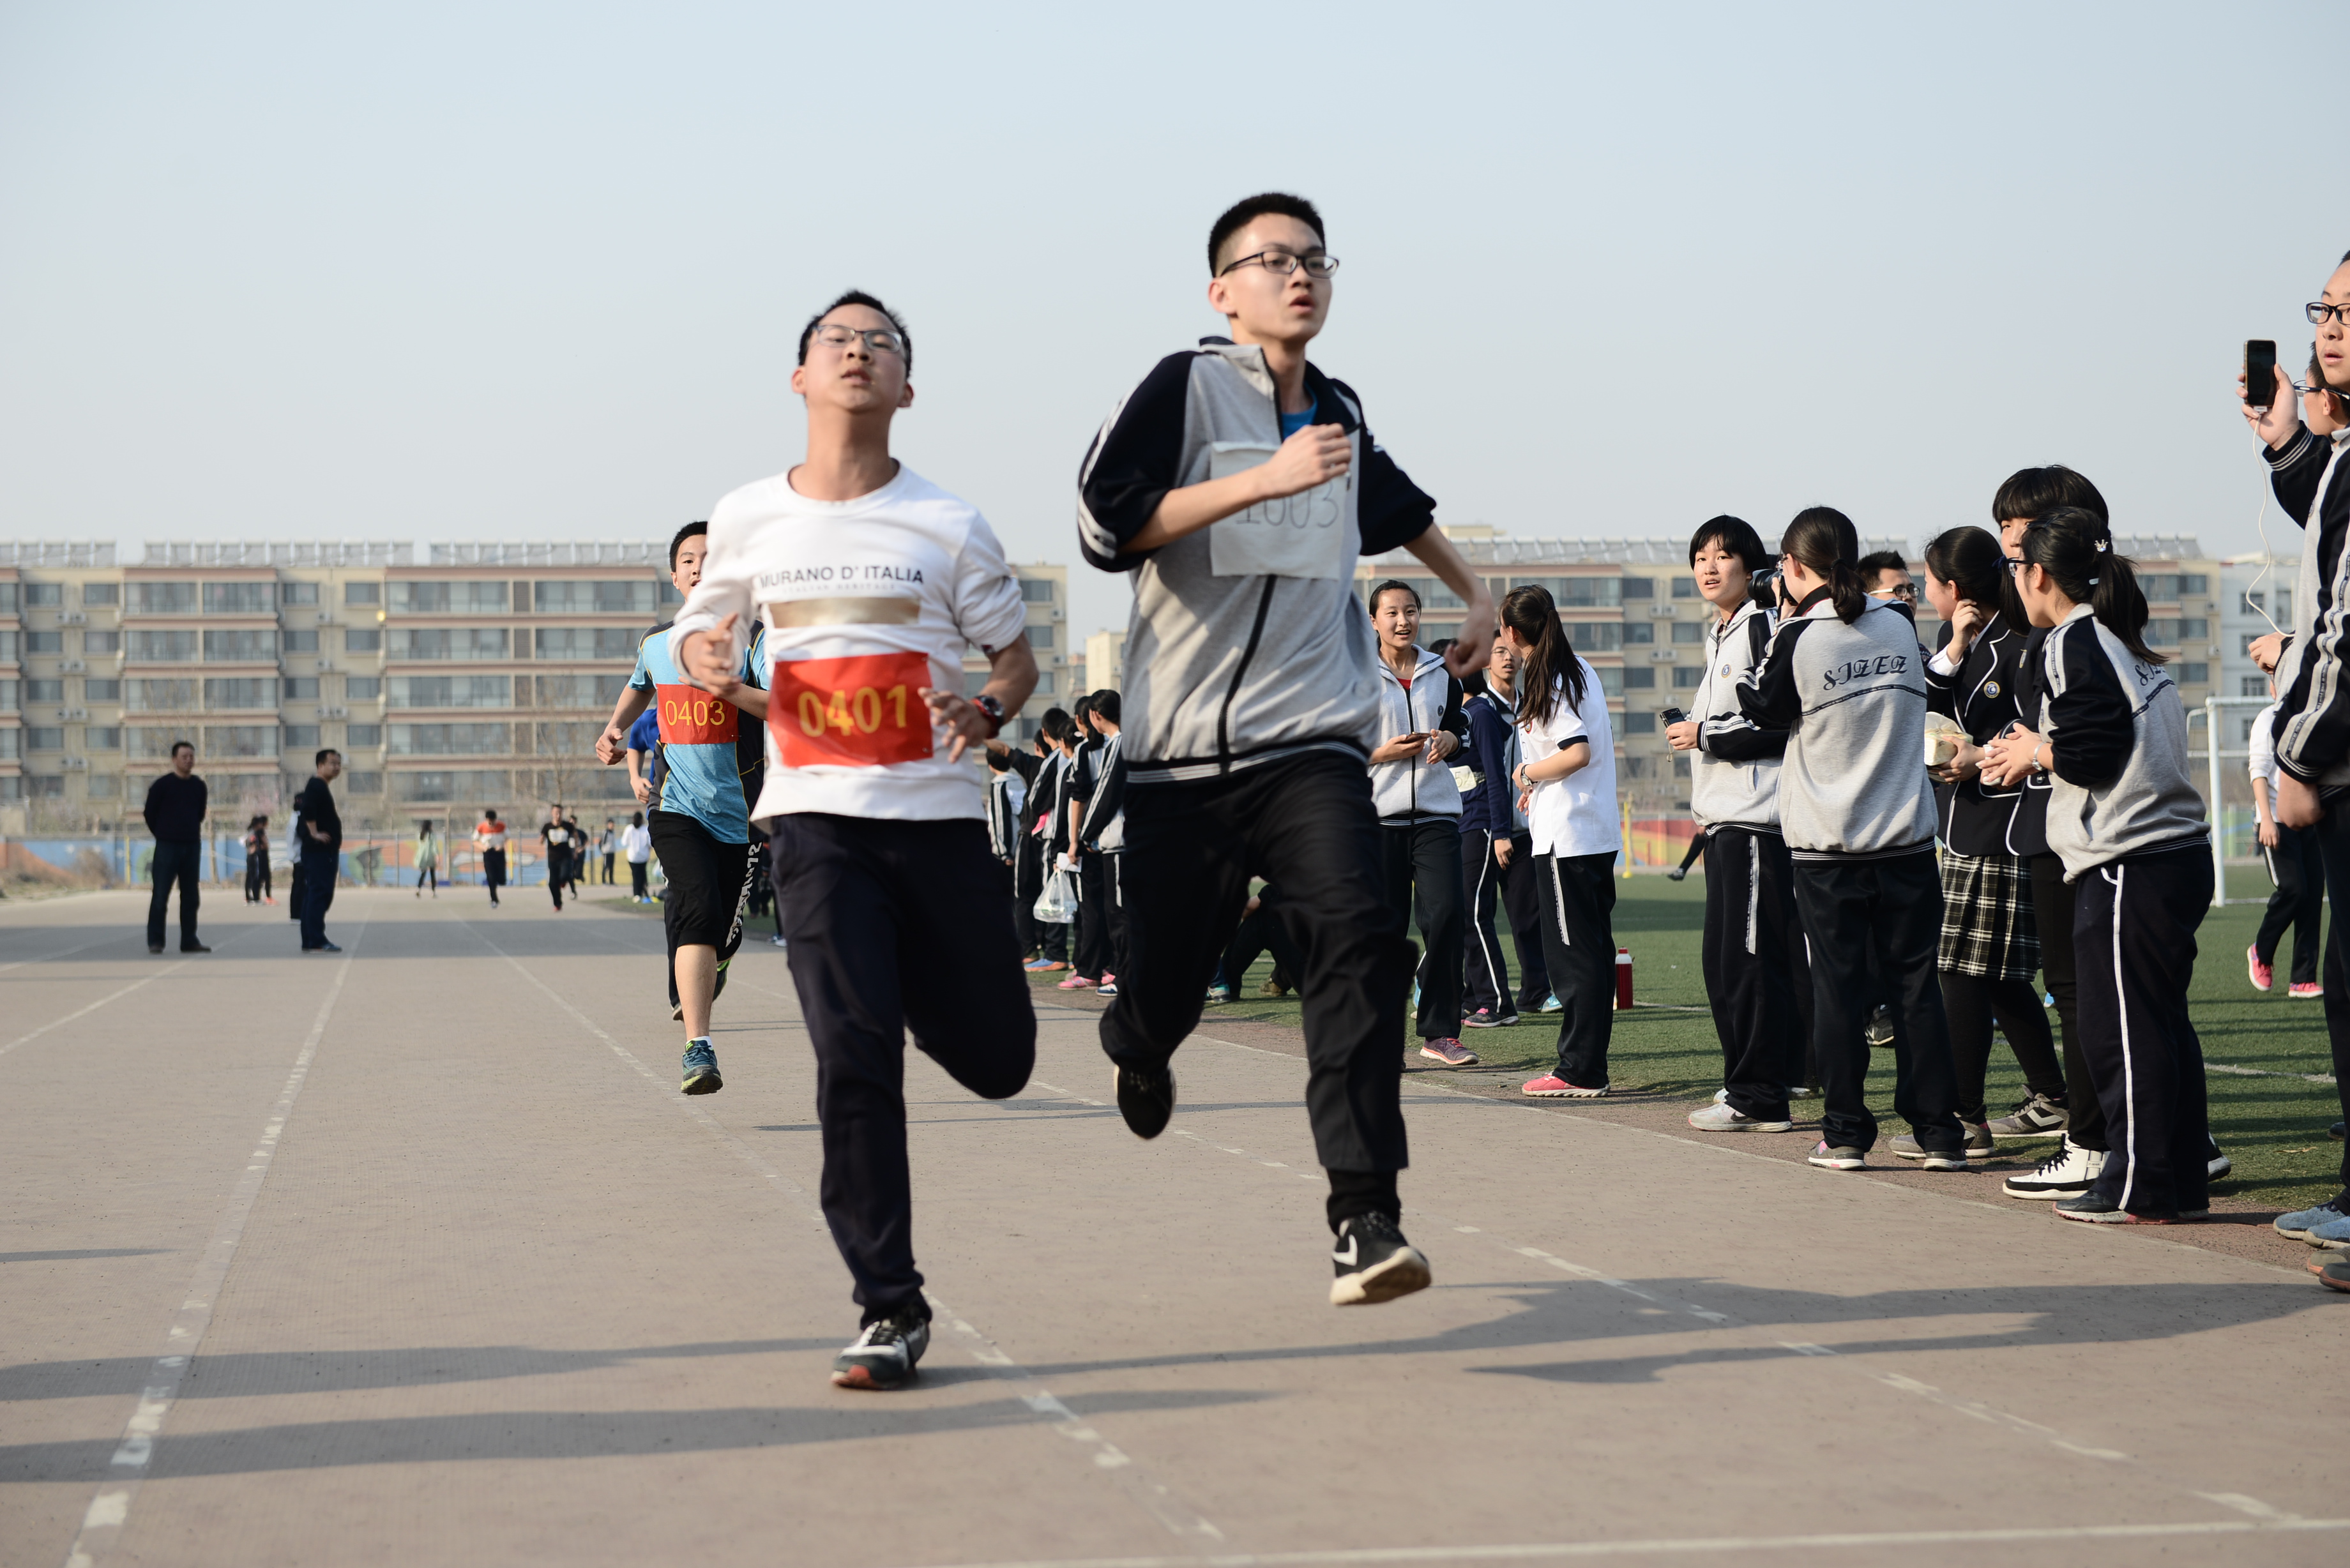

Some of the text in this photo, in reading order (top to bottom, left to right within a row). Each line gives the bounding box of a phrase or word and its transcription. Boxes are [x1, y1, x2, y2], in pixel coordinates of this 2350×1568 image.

[760, 566, 833, 588] MURANO
[665, 700, 725, 726] 0403
[798, 684, 907, 737] 0401
